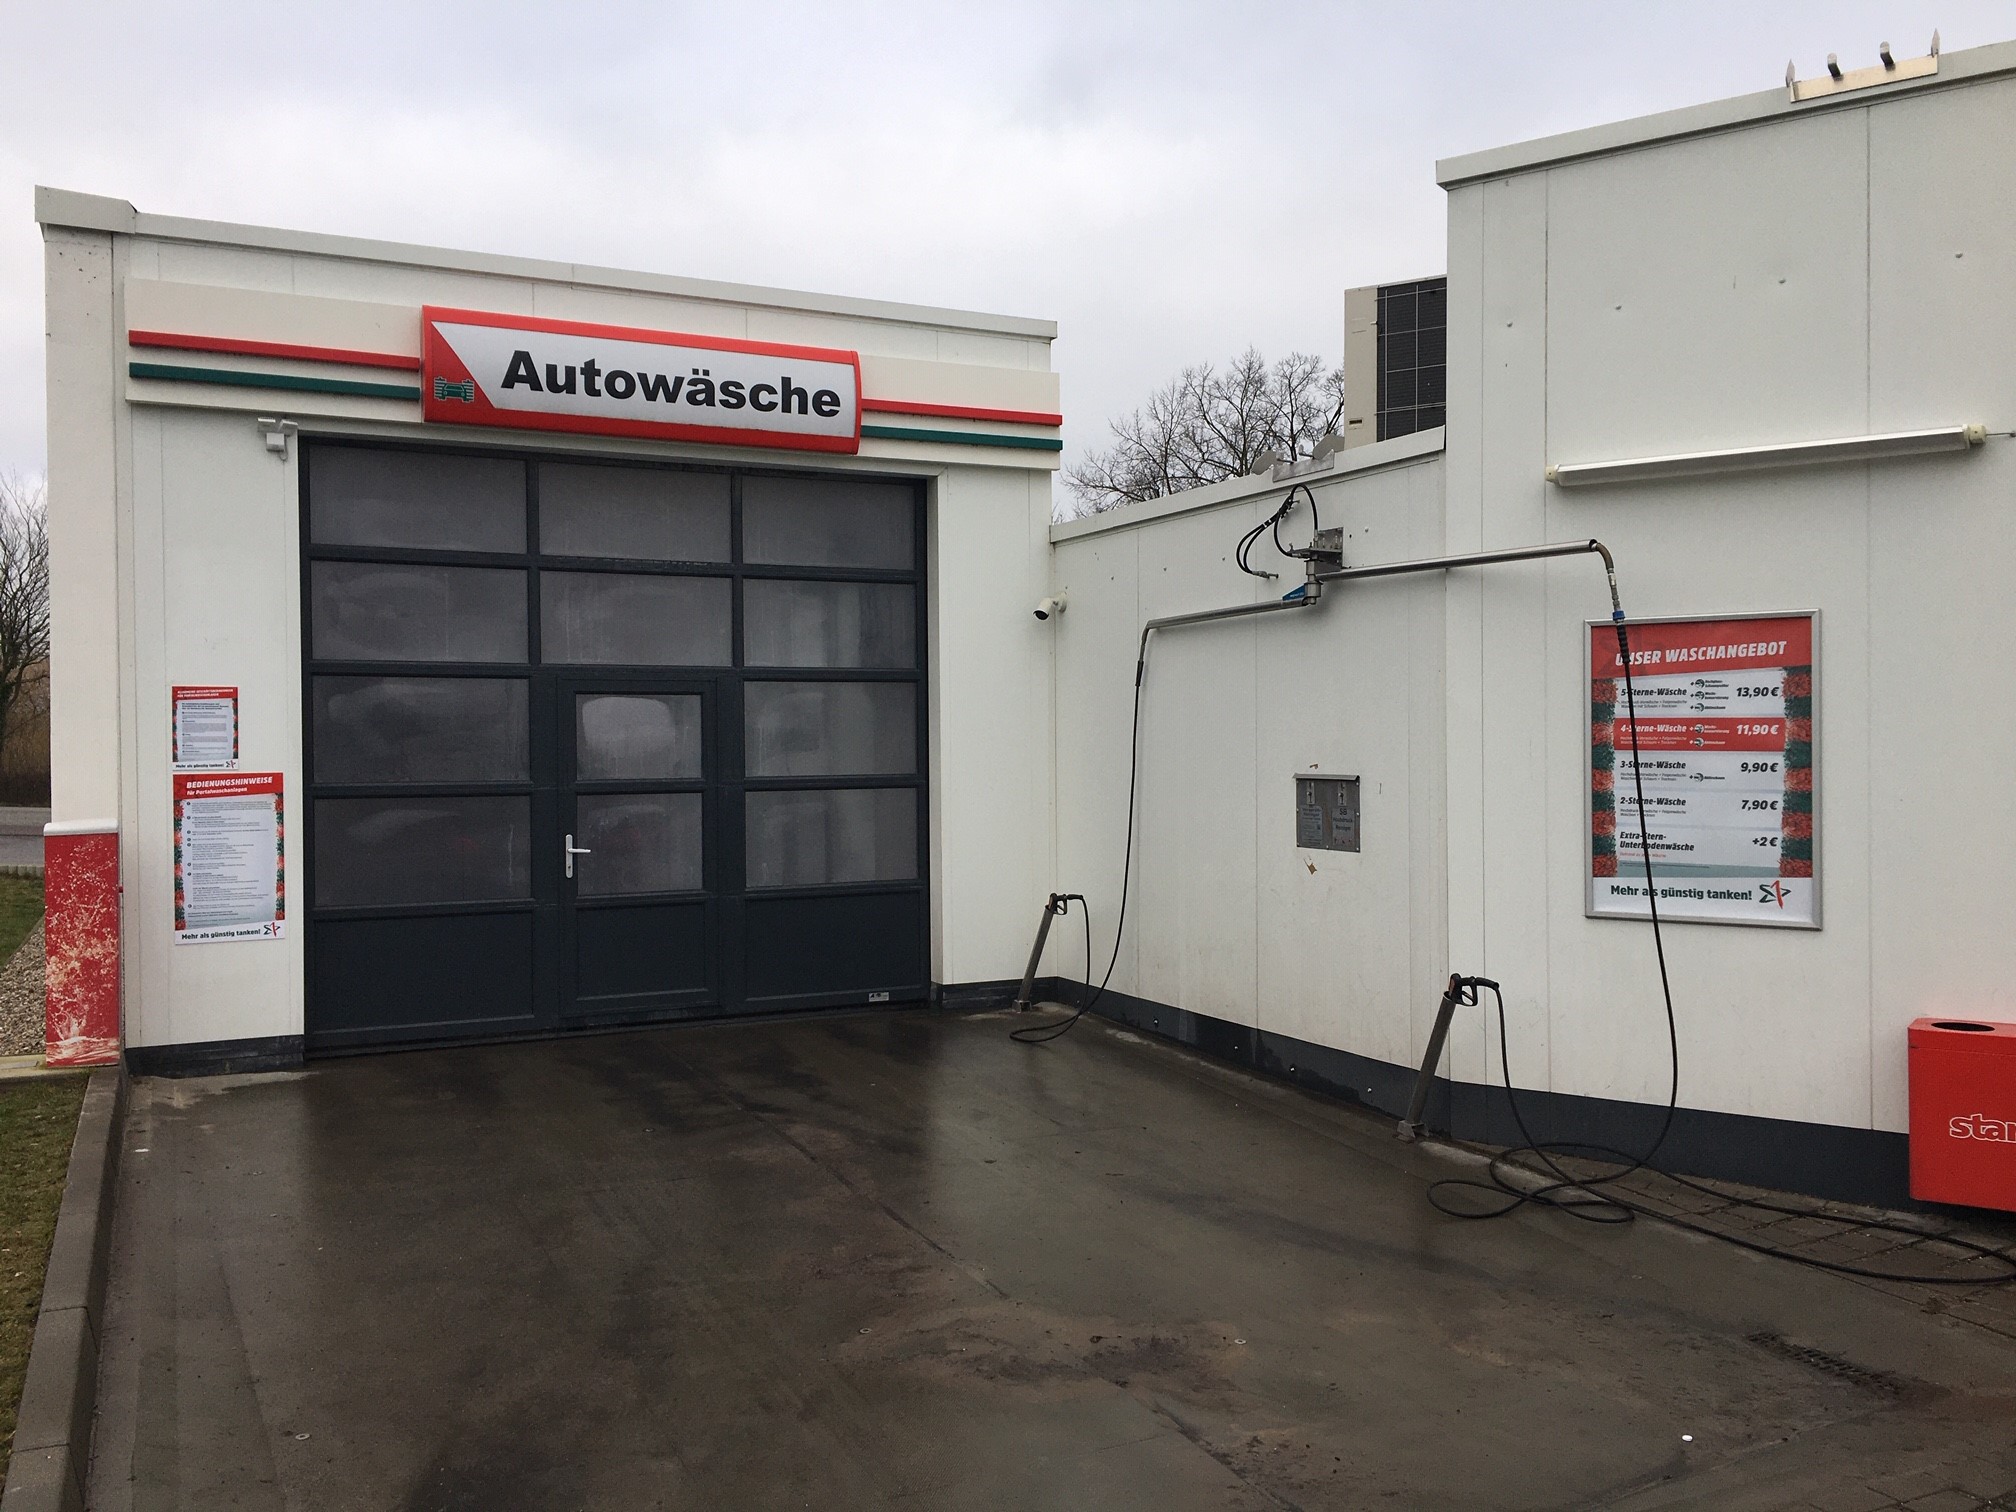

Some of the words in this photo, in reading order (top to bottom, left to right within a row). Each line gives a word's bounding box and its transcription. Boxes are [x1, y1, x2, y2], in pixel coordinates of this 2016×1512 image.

[500, 349, 842, 418] Autowäsche
[1665, 640, 1788, 663] WASCHANGEBOT
[1620, 723, 1687, 734] 4-Serne-Wäsche
[1620, 760, 1687, 770] 3-Srne-Wäsche
[186, 776, 272, 788] BEDIENUNGSHINWEISE
[1620, 796, 1687, 806] 2-Stene-Wäsche
[1610, 885, 1640, 897] Mehr
[1642, 888, 1659, 897] as
[1660, 887, 1705, 900] günstig
[1707, 889, 1753, 901] tanken!
[210, 930, 235, 939] günstig
[236, 928, 261, 936] tanken!
